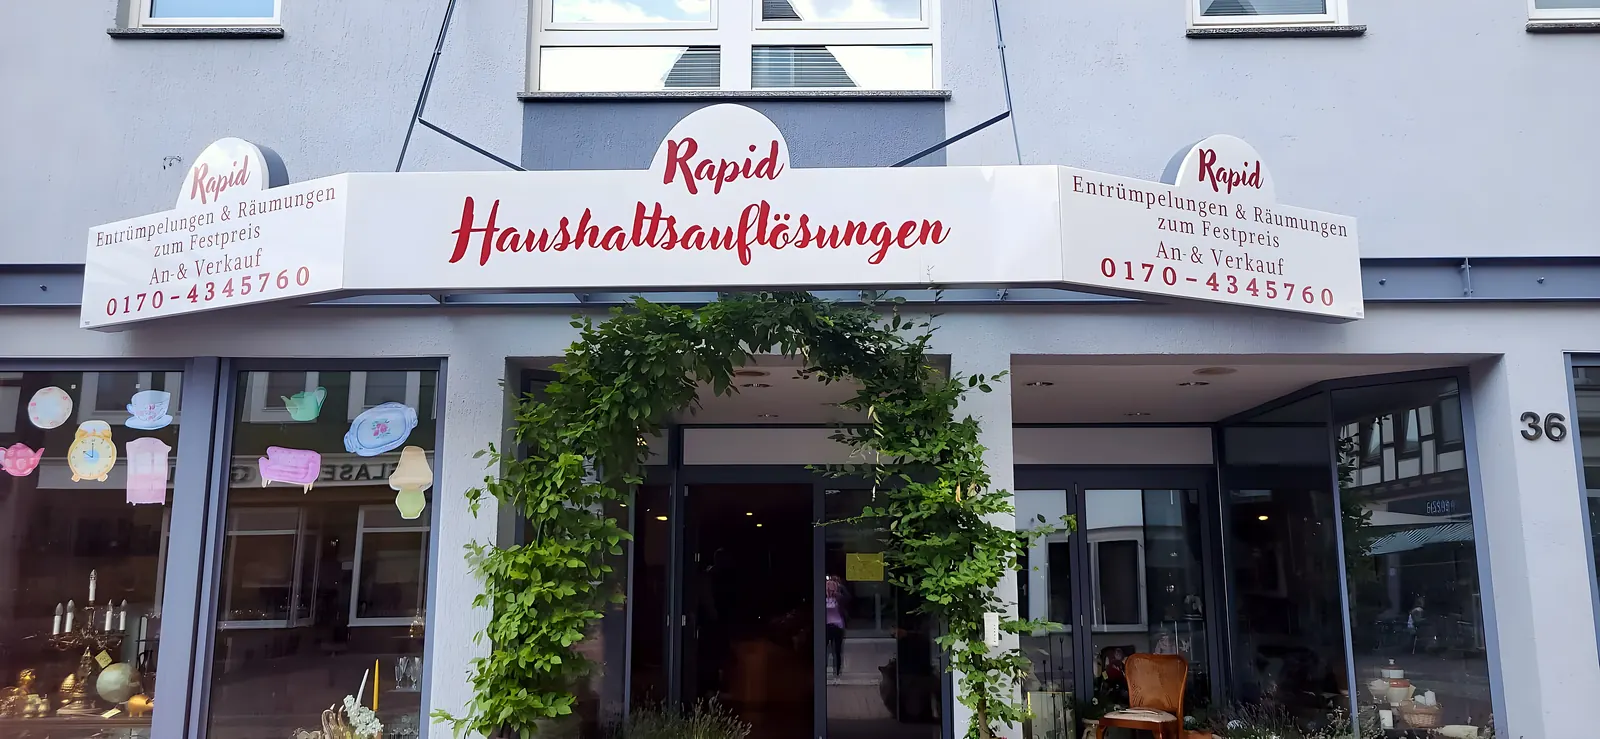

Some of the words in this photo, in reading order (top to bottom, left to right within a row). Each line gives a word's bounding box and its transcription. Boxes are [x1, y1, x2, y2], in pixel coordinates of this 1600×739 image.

[189, 155, 250, 204] Rapid
[663, 137, 784, 195] Rapid
[1199, 149, 1264, 194] Rapid
[96, 213, 214, 247] Entrümpelungen
[221, 206, 230, 222] &
[238, 187, 335, 218] Räumungen
[449, 196, 951, 266] Haushaltsauflösungen
[1073, 176, 1228, 217] Entrümpelungen
[1236, 204, 1246, 220] &
[1254, 206, 1347, 238] Räumungen
[154, 241, 183, 257] zum
[190, 224, 260, 250] Festpreis
[1158, 217, 1194, 234] zum
[1201, 220, 1279, 248] Festpreis
[195, 248, 262, 277] Verkauf
[1101, 258, 1333, 306] 0170-4345760
[1211, 249, 1283, 275] Verkauf
[107, 266, 309, 316] 0170-4345760
[1520, 411, 1567, 442] 36
